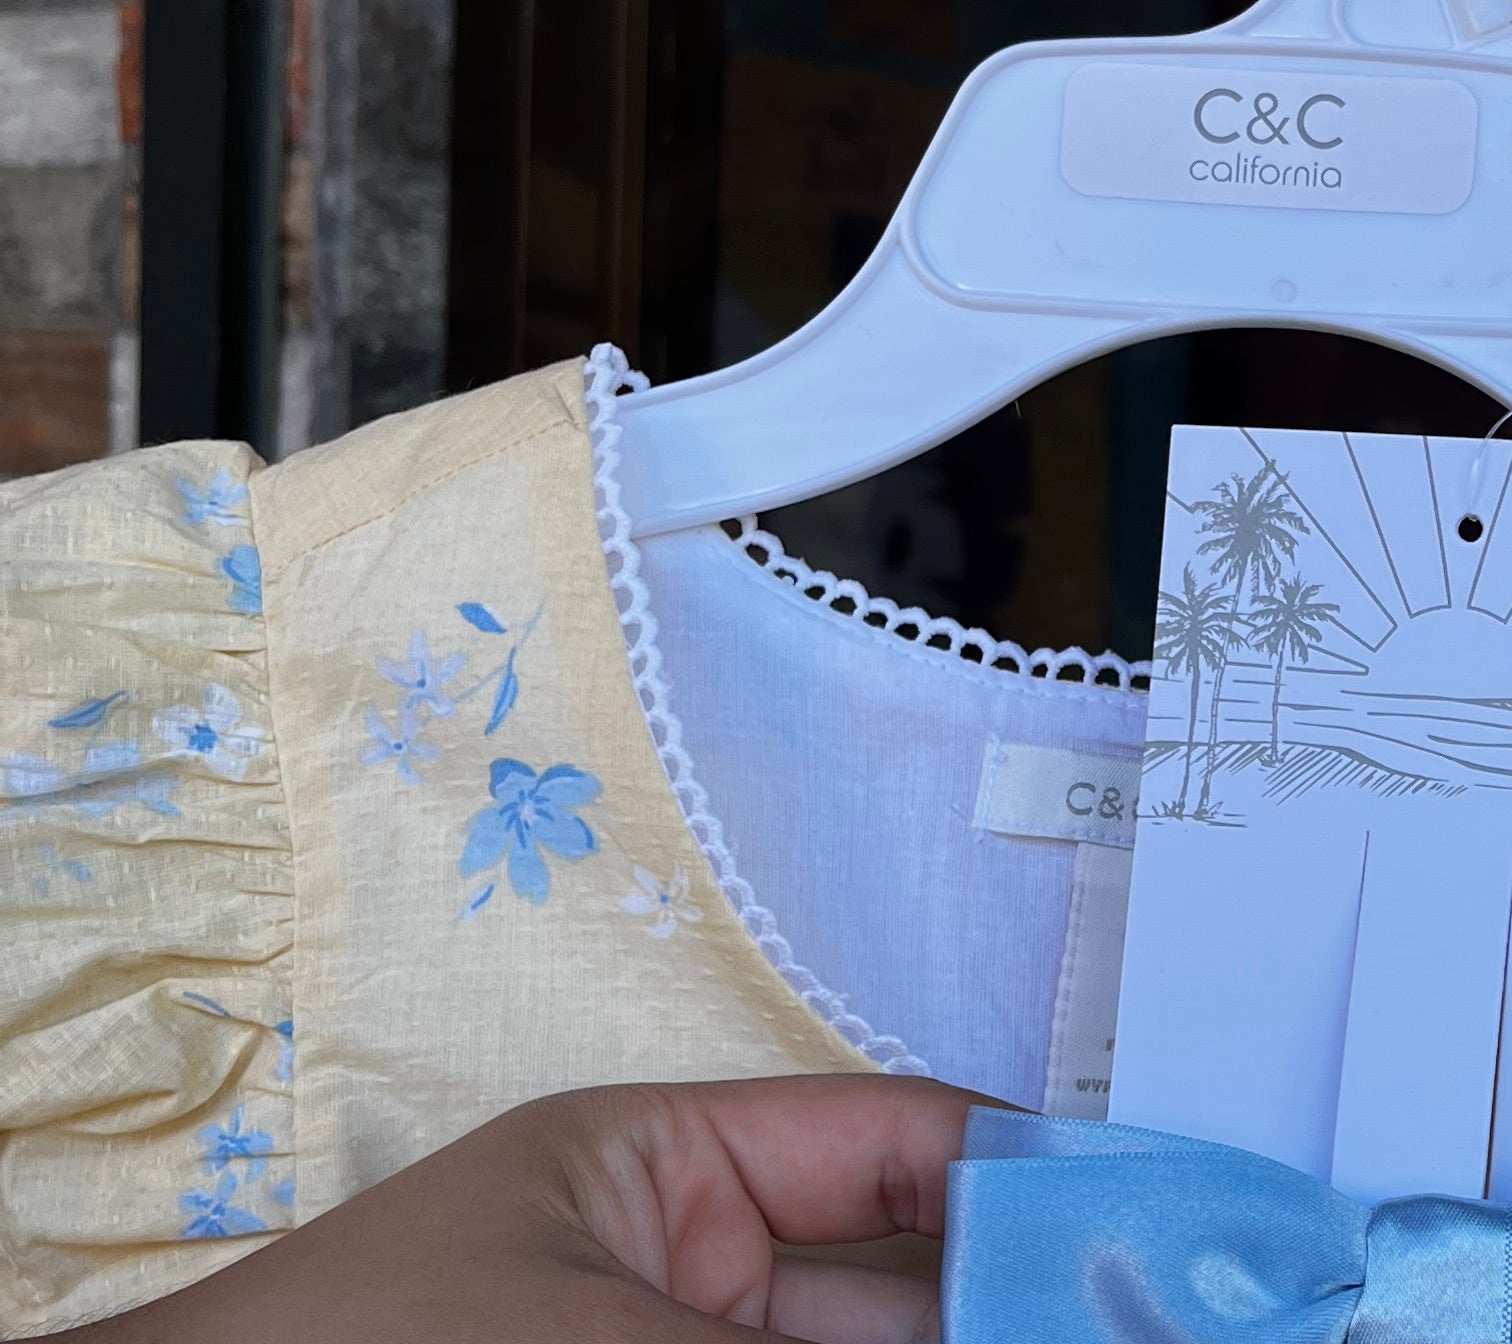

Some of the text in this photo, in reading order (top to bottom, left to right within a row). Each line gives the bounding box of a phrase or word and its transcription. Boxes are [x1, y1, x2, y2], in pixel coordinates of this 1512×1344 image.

[1193, 87, 1347, 150] C&C
[1189, 153, 1343, 190] california
[1065, 781, 1139, 822] C&
